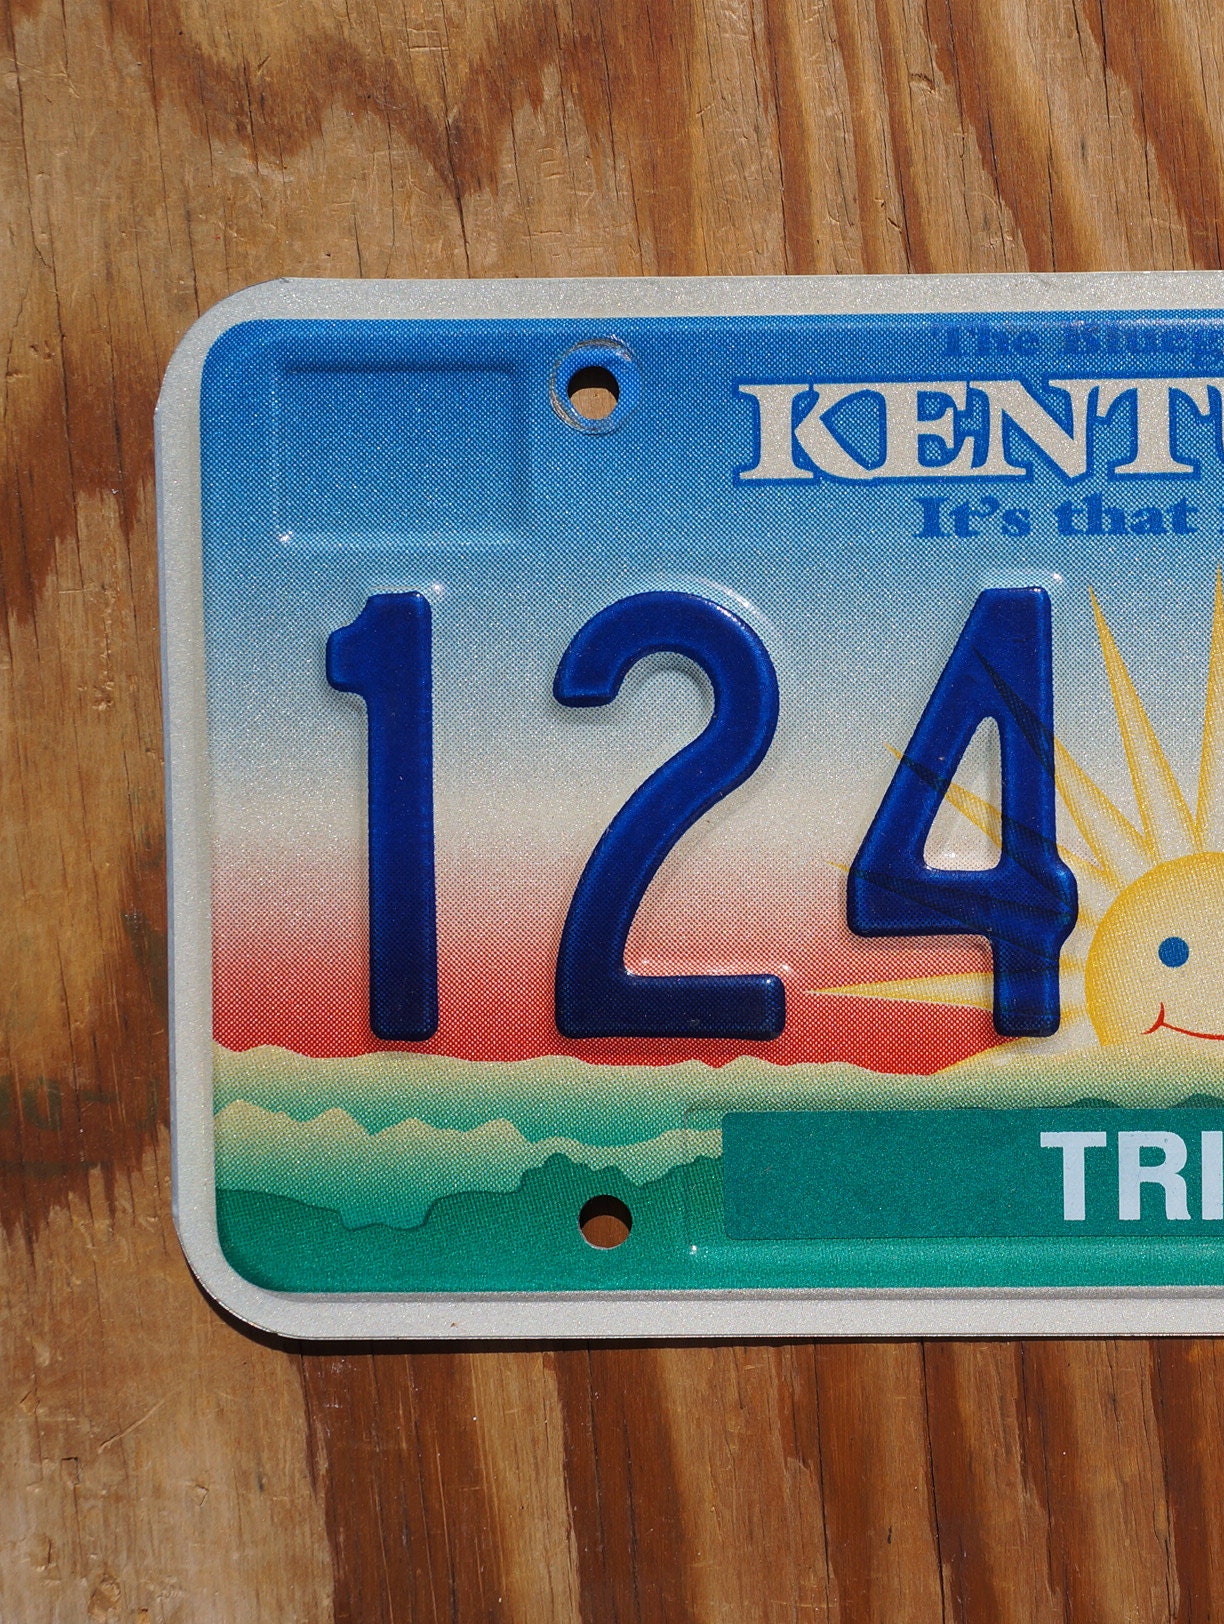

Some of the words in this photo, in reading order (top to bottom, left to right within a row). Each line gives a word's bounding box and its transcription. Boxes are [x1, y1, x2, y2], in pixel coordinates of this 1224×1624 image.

[932, 324, 1041, 357] The
[1054, 492, 1204, 537] that
[325, 587, 1079, 1042] 124
